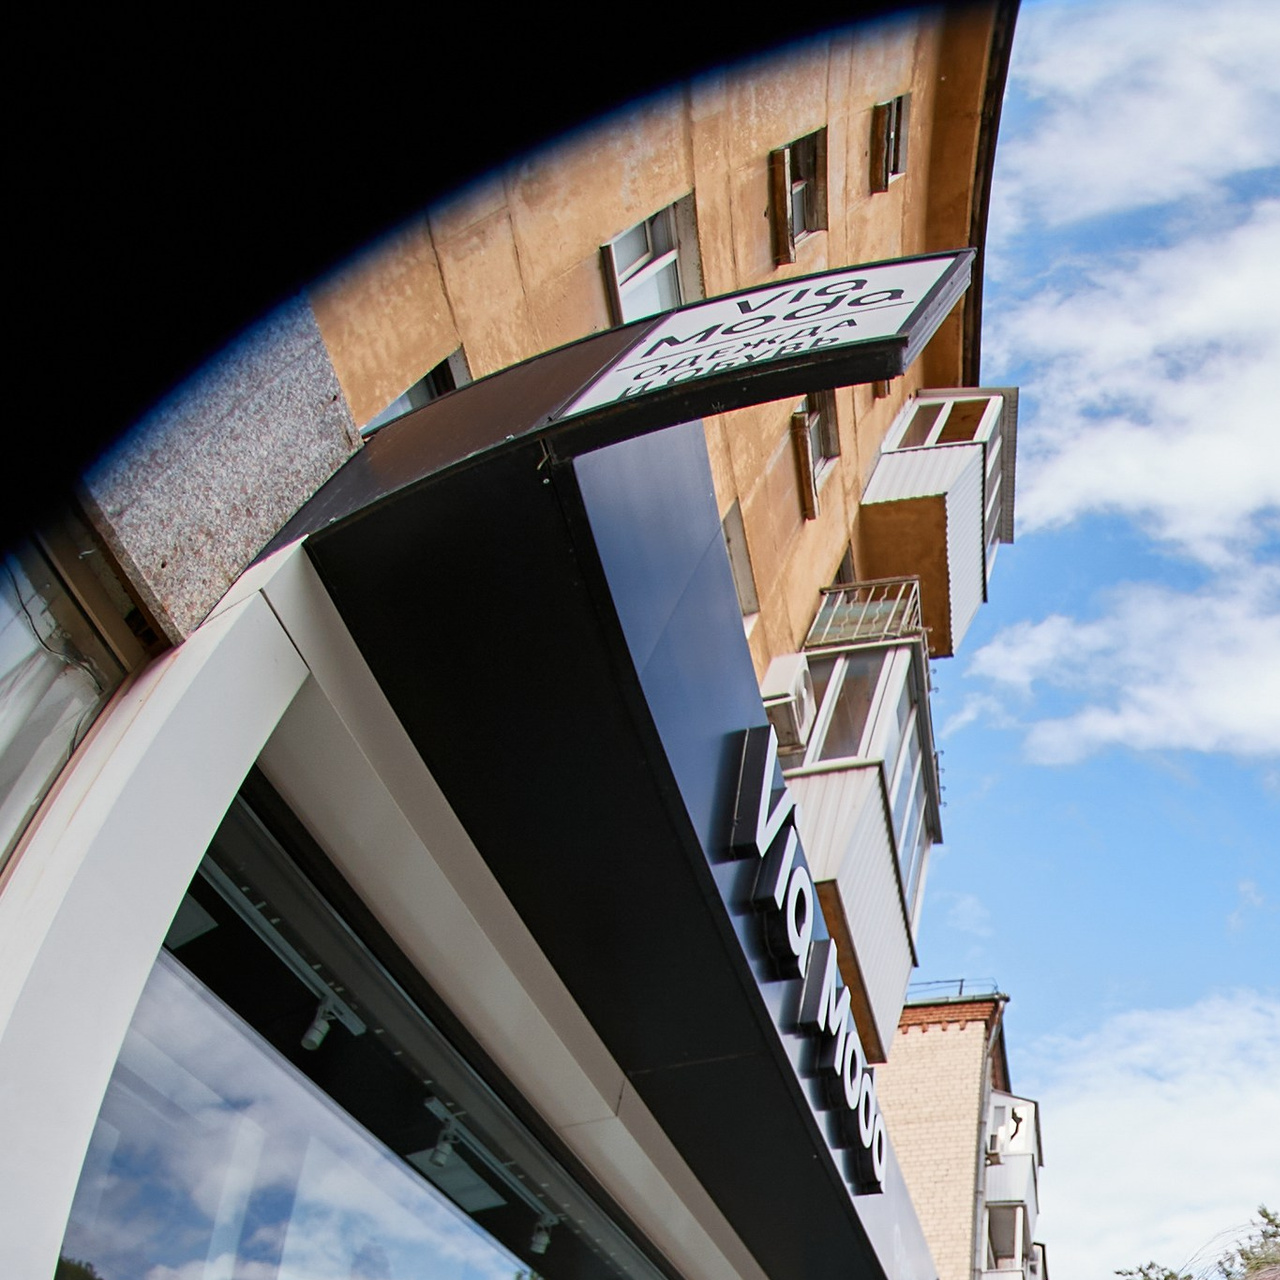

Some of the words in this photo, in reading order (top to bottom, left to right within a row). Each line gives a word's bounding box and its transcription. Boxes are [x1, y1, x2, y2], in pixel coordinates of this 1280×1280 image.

[642, 288, 905, 358] Moda
[737, 279, 867, 315] Via
[633, 318, 858, 380] ОДЕЖДА
